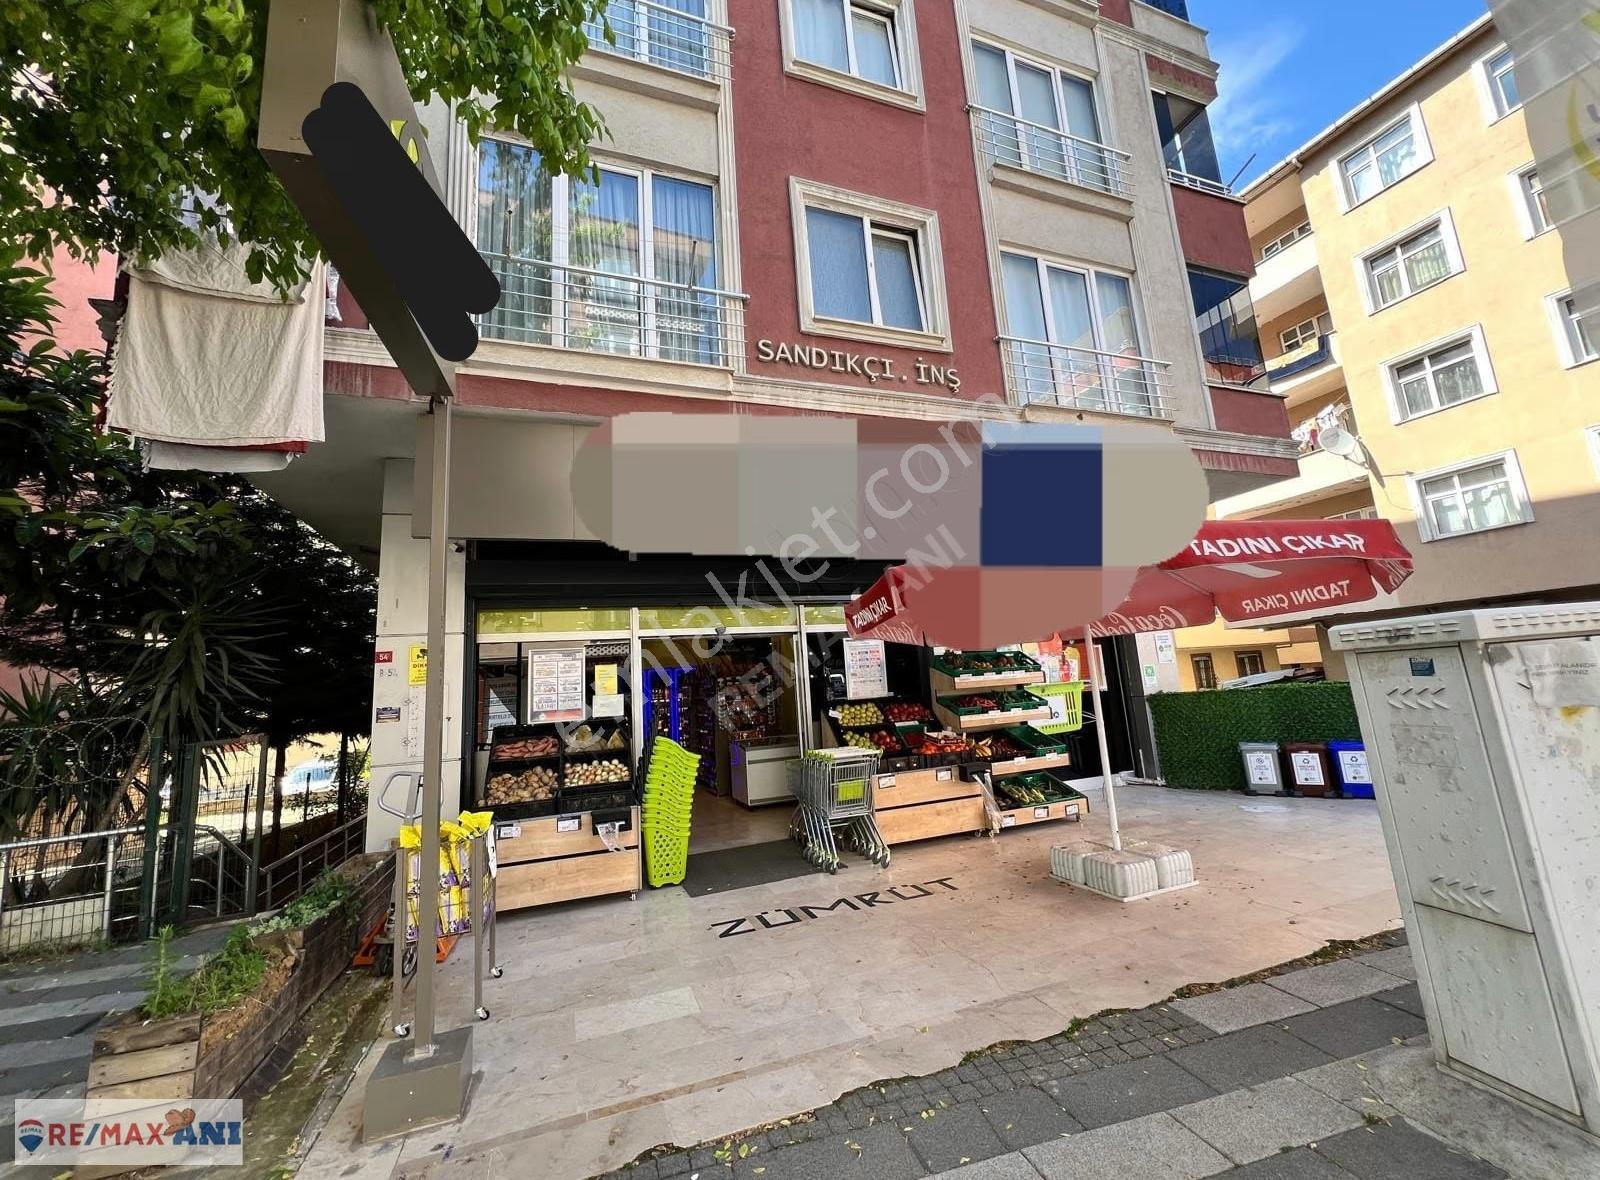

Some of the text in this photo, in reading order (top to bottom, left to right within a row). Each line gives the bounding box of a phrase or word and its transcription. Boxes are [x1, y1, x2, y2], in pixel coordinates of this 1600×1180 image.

[1189, 533, 1366, 557] TADINI ÇIKAR
[869, 596, 893, 622] ÇIKAR
[379, 653, 389, 661] 54
[711, 877, 959, 939] ZÜMRÜT
